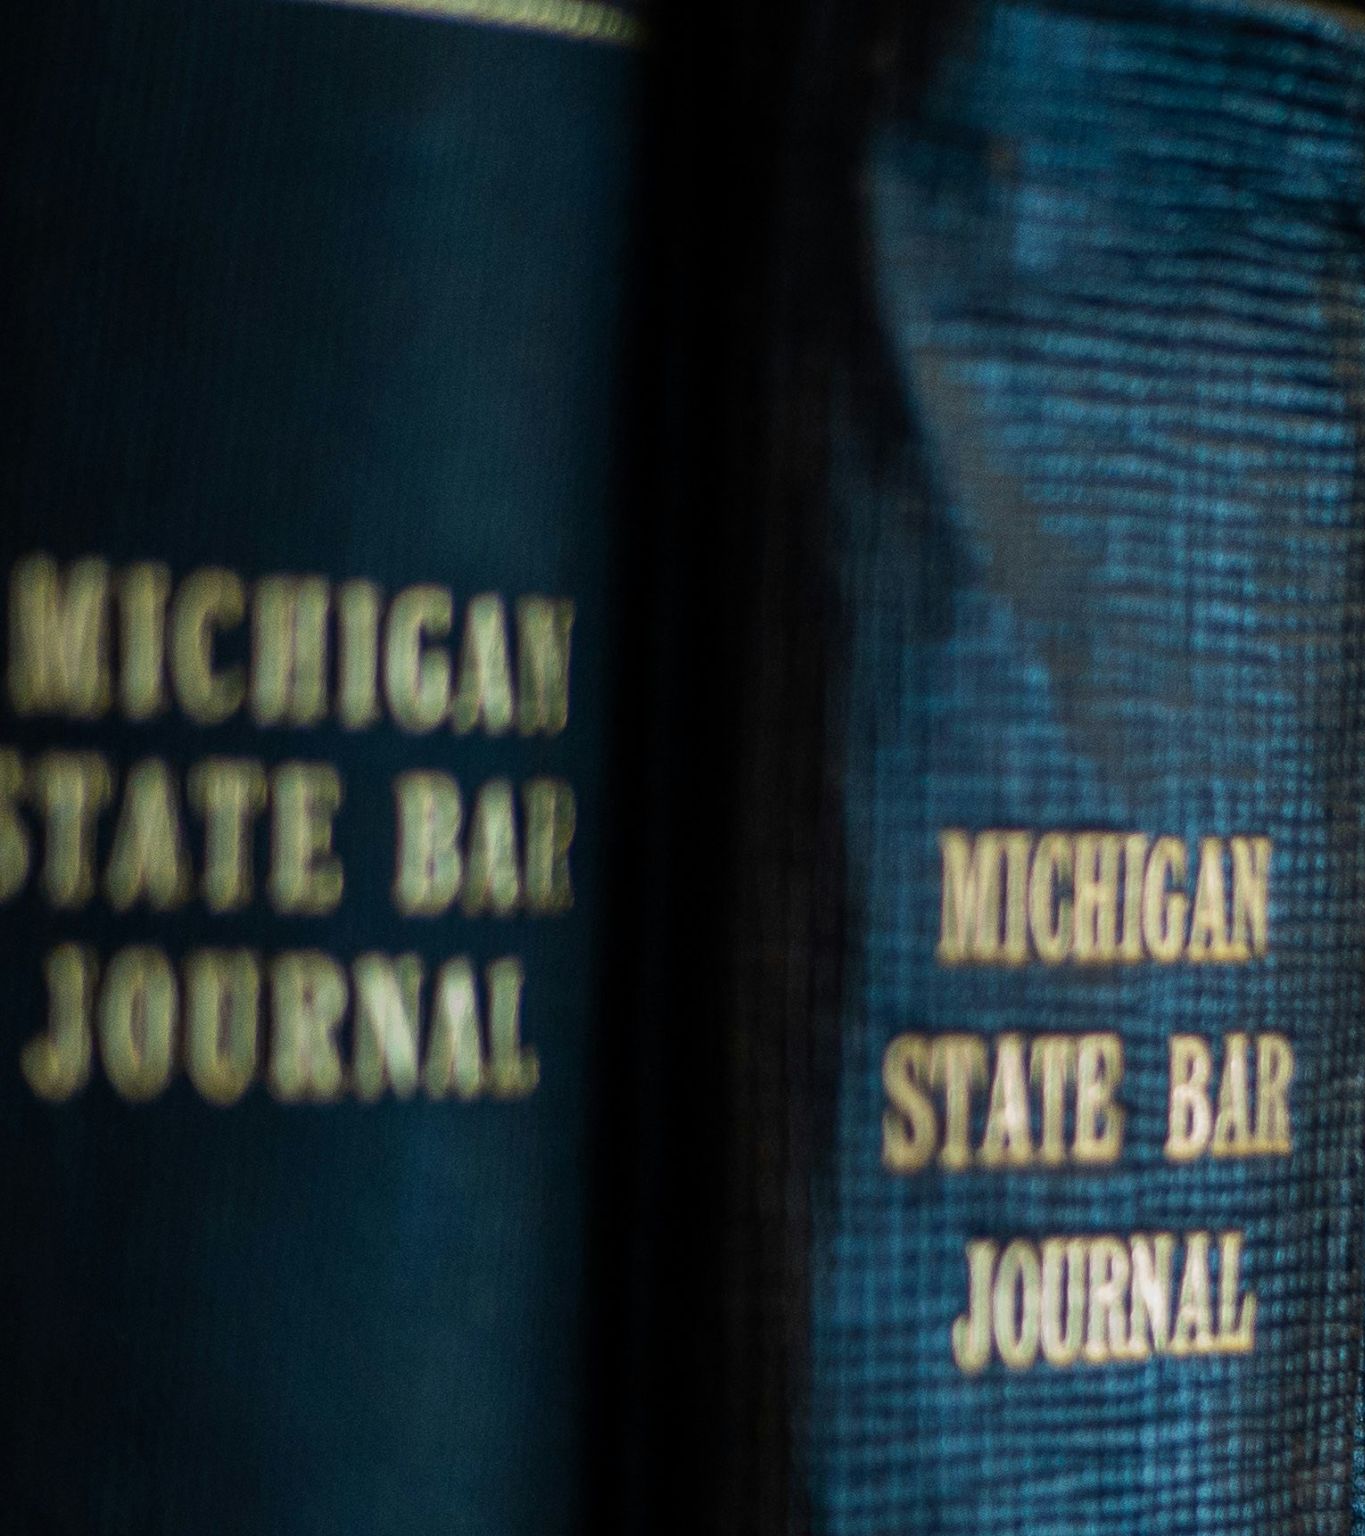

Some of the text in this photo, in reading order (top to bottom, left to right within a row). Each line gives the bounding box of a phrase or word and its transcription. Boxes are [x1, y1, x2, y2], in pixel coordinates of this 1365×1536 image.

[7, 553, 576, 736] MICHIGAN
[395, 770, 577, 917] BAR
[939, 828, 1272, 965] MICHIGAN
[20, 942, 540, 1104] JOURNAL
[882, 1032, 1295, 1173] STATE BAR
[951, 1230, 1257, 1375] JOURNAL
